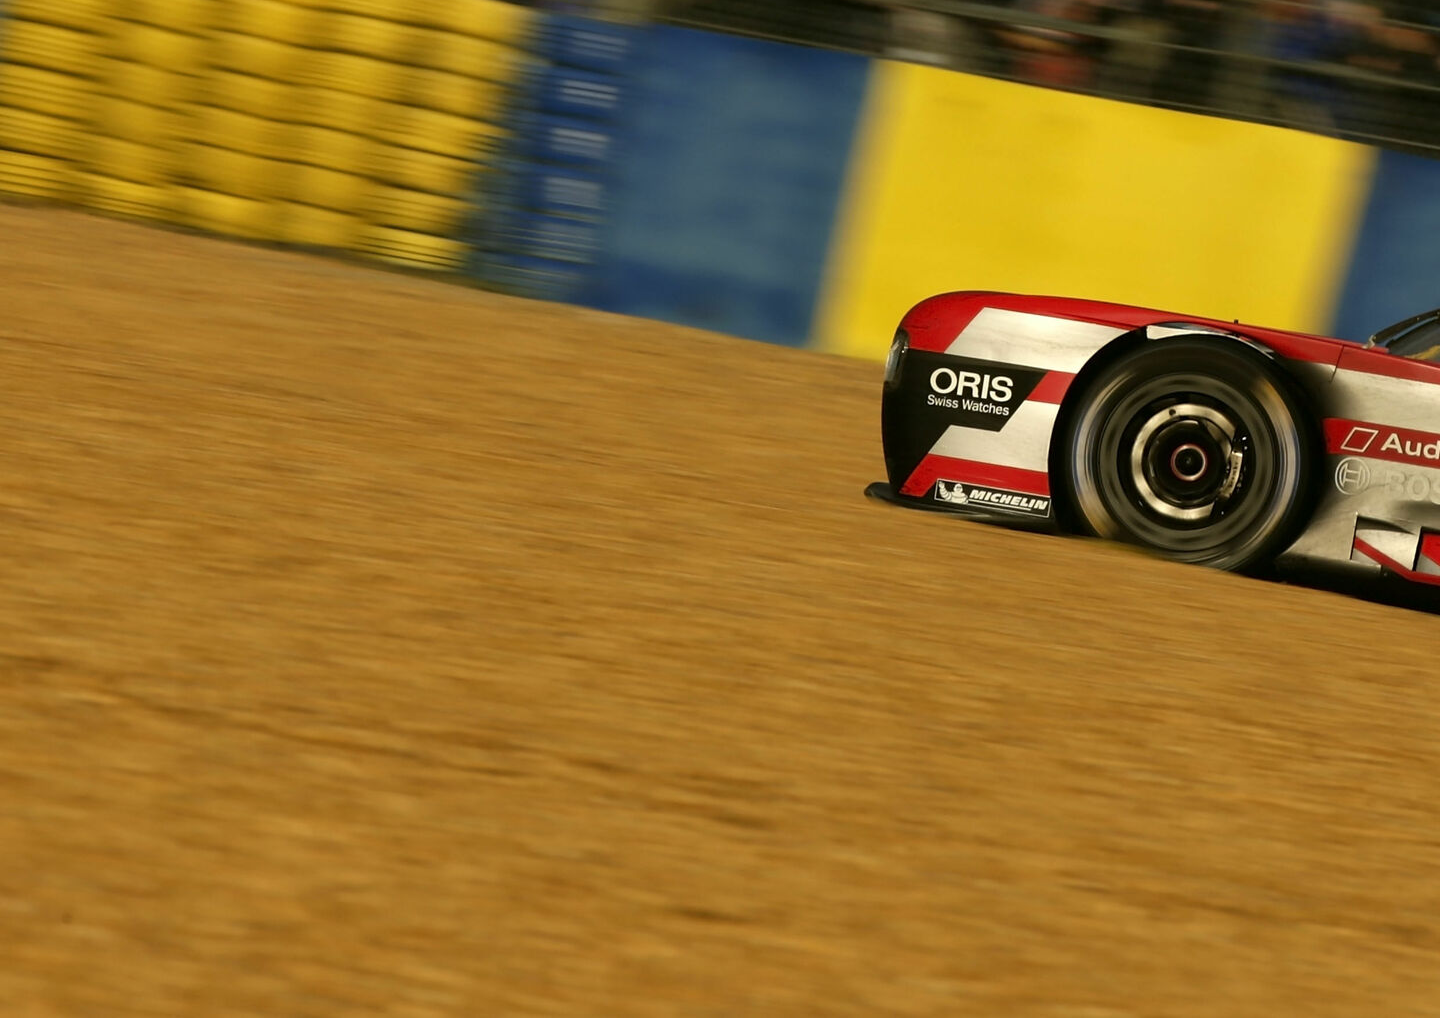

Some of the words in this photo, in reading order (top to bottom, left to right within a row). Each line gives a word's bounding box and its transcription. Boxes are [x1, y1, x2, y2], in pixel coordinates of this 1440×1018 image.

[929, 367, 1014, 402] ORIS
[926, 393, 959, 409] Swiss
[962, 398, 1010, 416] Watches
[969, 489, 1048, 511] MICHELIN
